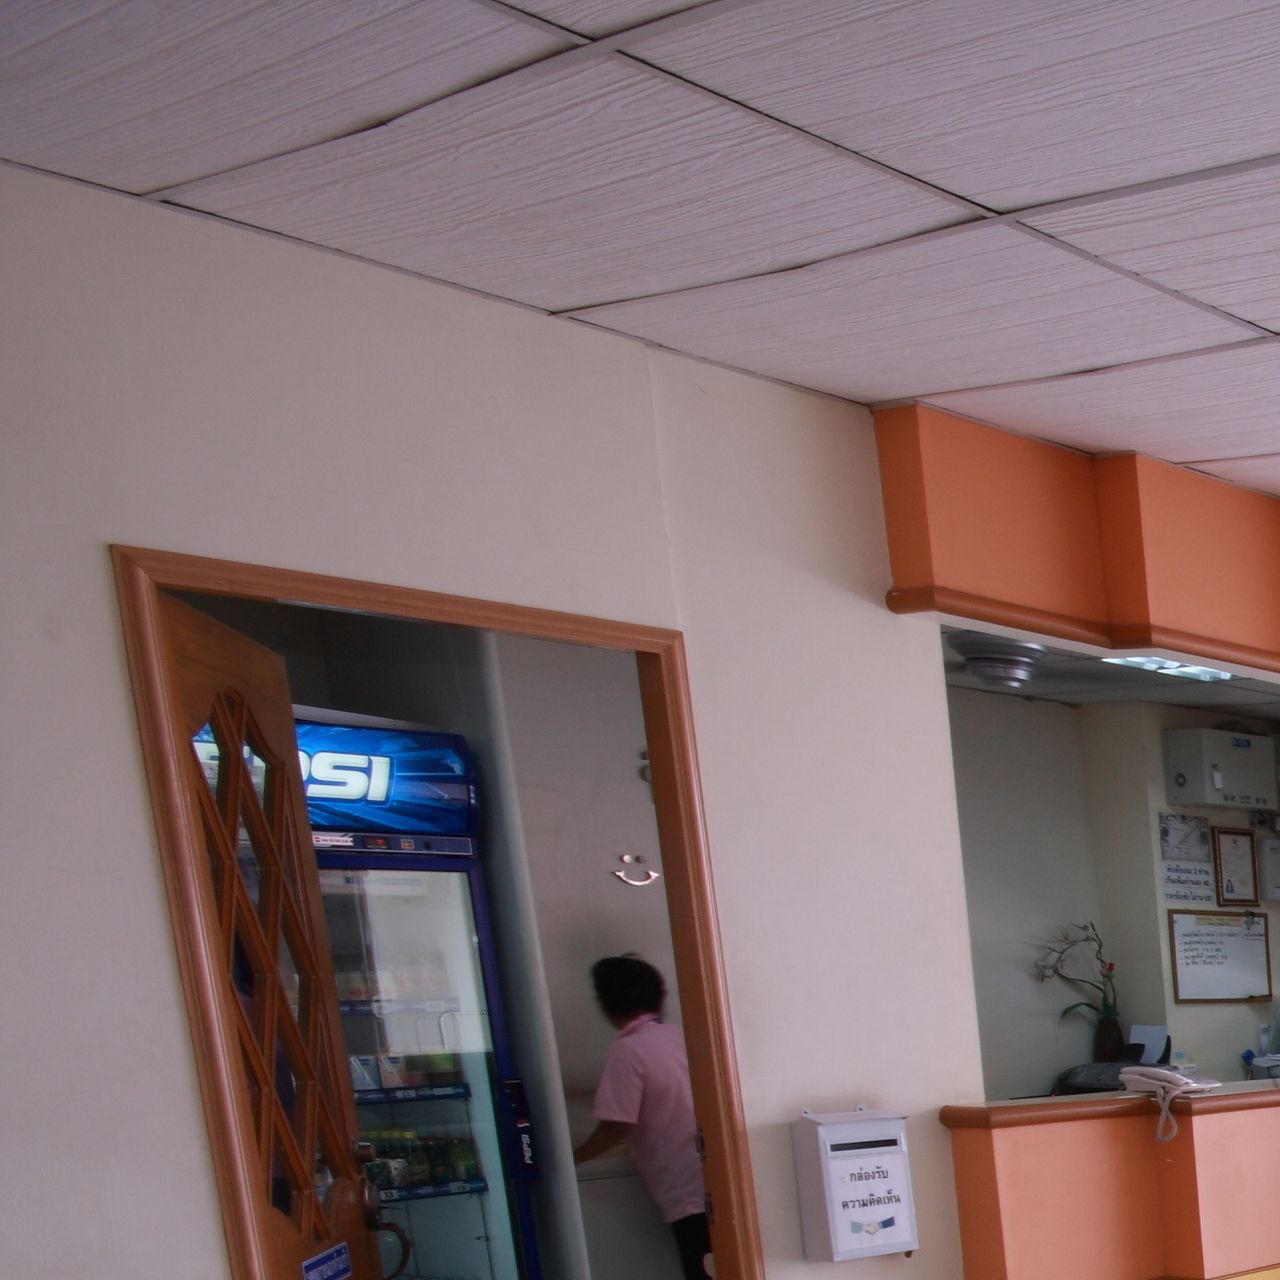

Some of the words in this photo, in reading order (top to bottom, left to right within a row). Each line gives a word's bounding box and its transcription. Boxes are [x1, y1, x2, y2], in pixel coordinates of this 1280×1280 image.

[849, 1165, 889, 1183] กล่องรับ
[841, 1188, 901, 1211] ความคิดเห็น
